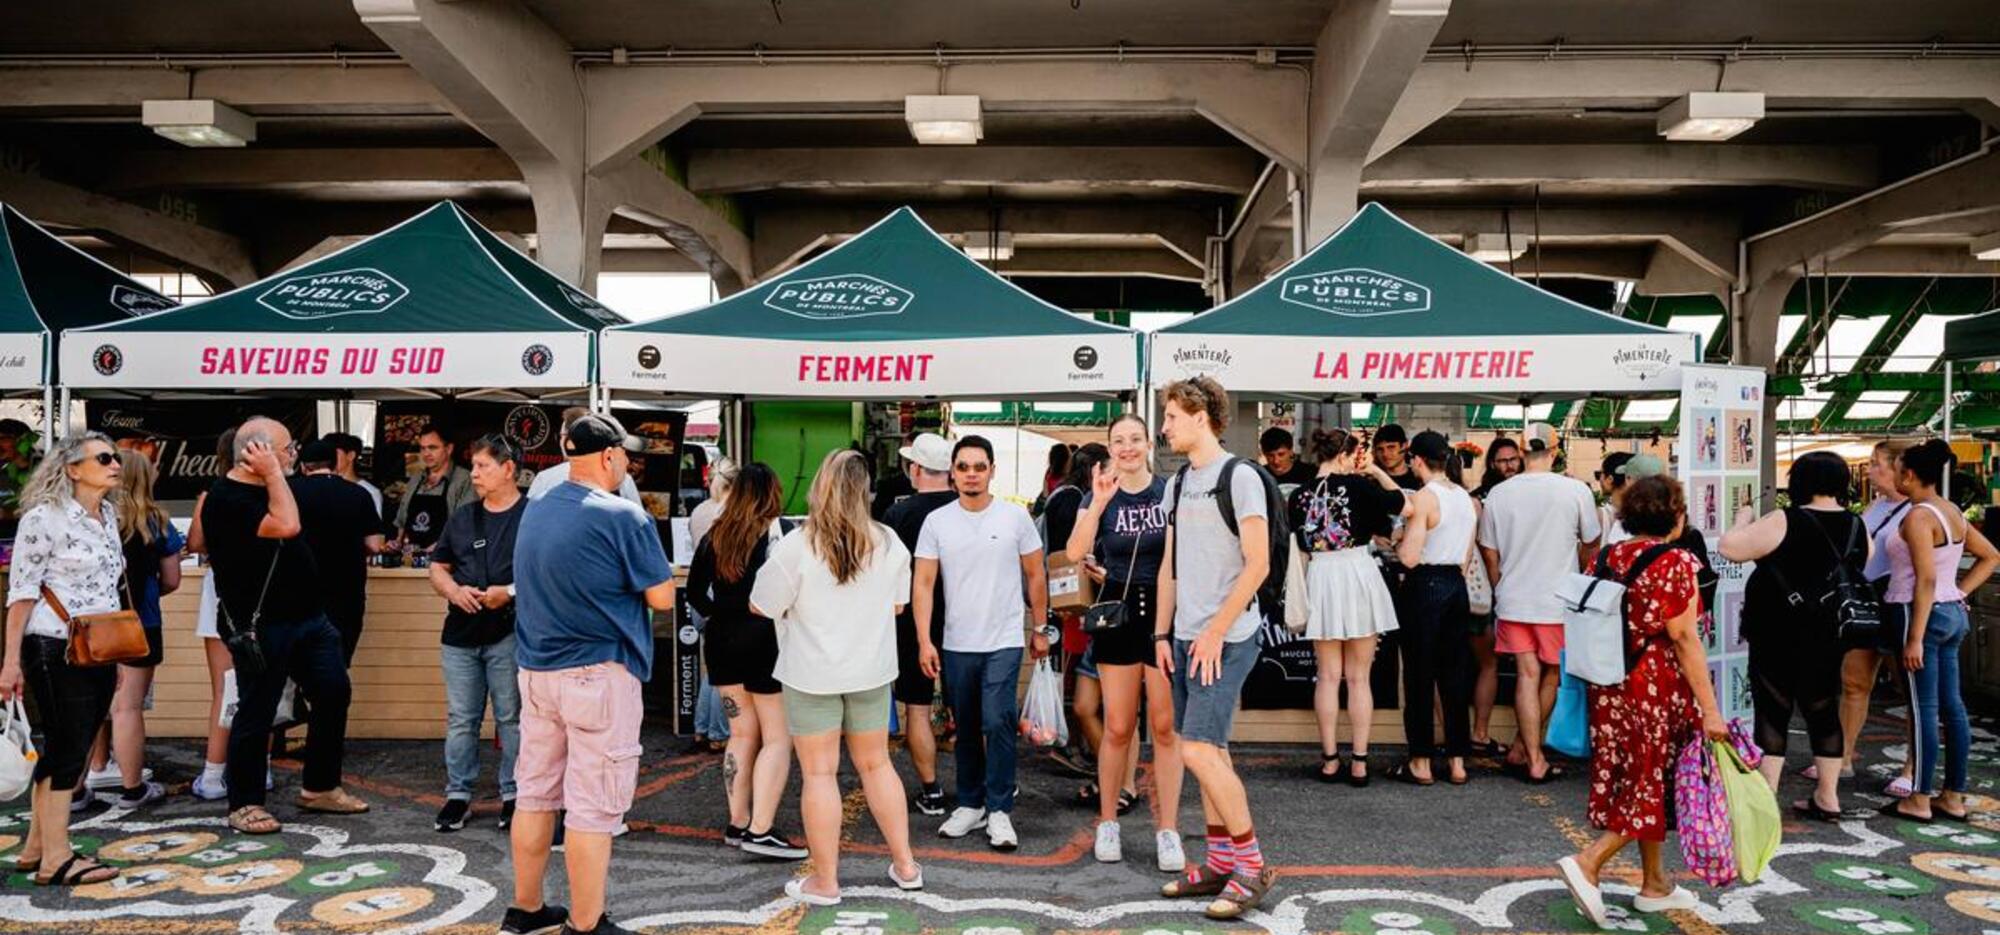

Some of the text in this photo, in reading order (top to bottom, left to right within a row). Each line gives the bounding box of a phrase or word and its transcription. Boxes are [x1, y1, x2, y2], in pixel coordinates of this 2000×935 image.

[276, 285, 390, 304] PUBLICS
[779, 290, 899, 306] PUBLICS
[1293, 284, 1419, 302] PUBLICS
[200, 347, 446, 375] SAVEURS DU SUD
[798, 354, 934, 383] FERMENT
[1312, 350, 1535, 379] LA PIMENTERIE
[1115, 504, 1166, 533] AERO
[681, 655, 693, 715] Ferment
